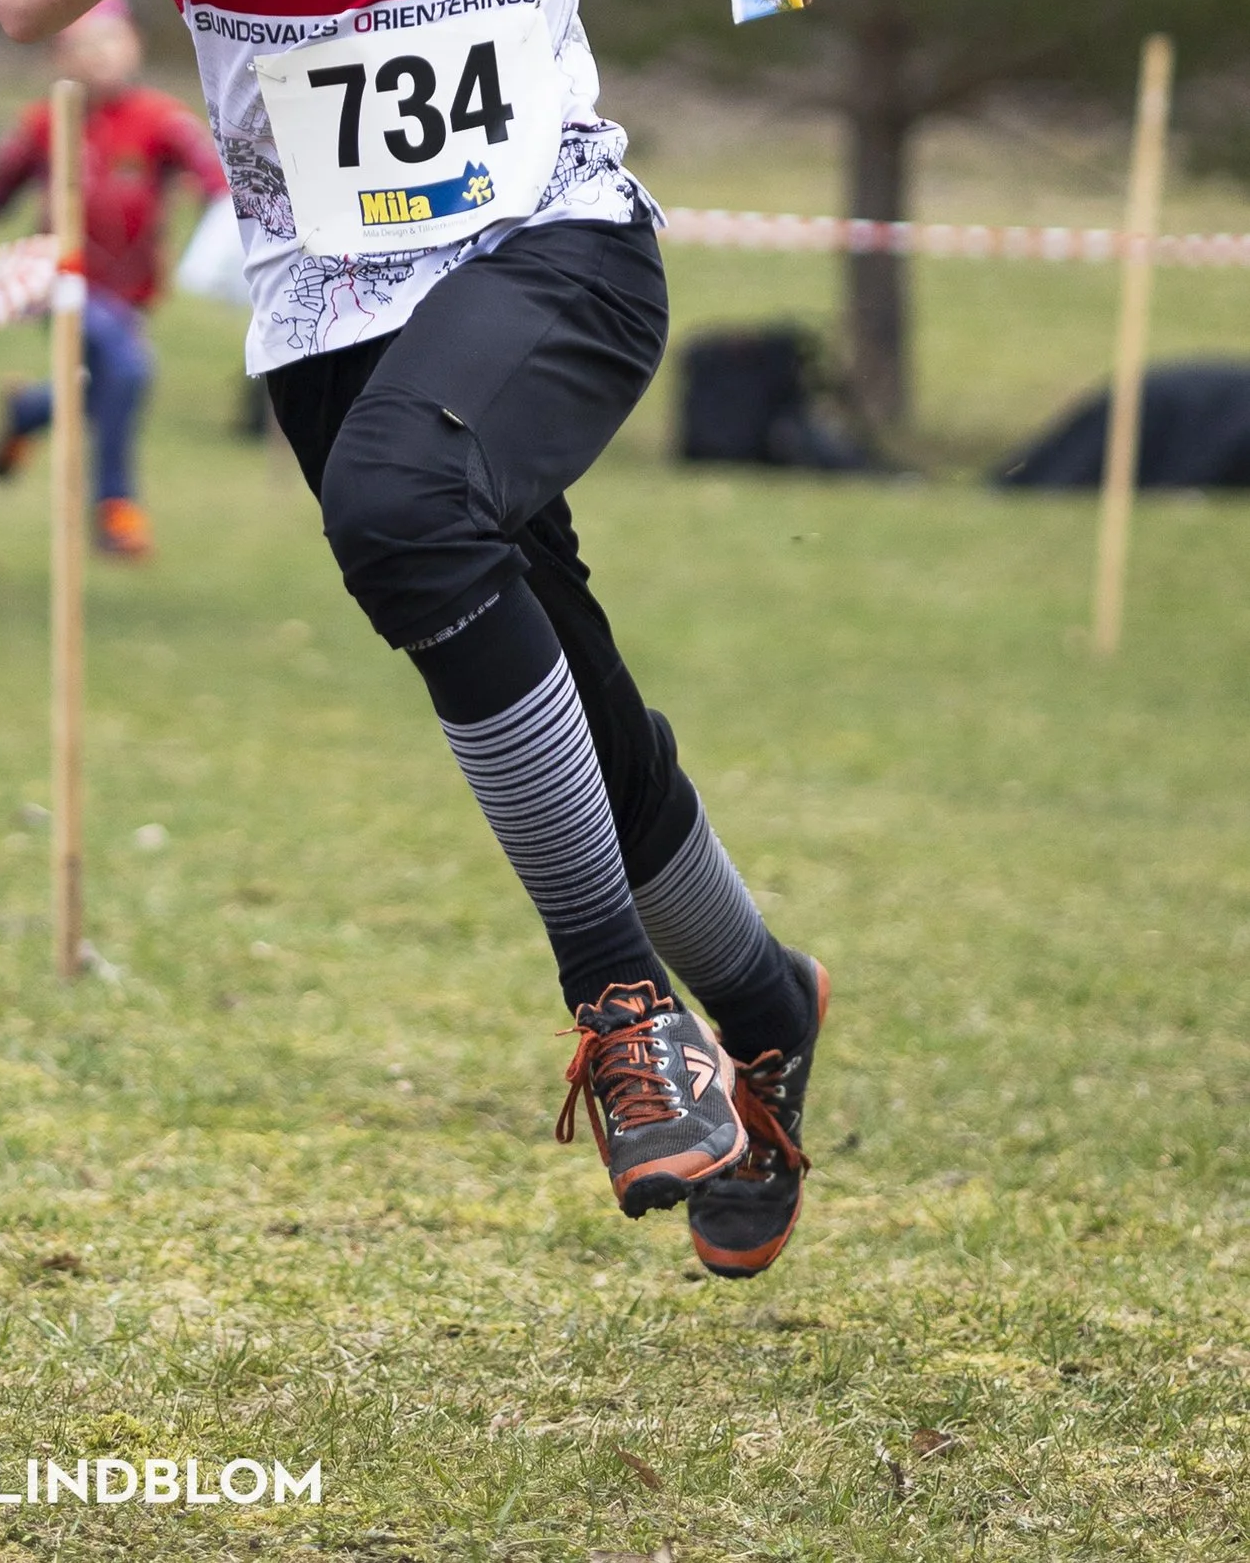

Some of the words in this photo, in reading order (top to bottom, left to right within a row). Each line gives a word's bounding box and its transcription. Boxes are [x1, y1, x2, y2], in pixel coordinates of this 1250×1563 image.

[307, 40, 514, 169] 734
[360, 190, 433, 225] Mila
[362, 228, 380, 239] Mila
[381, 227, 408, 239] Design
